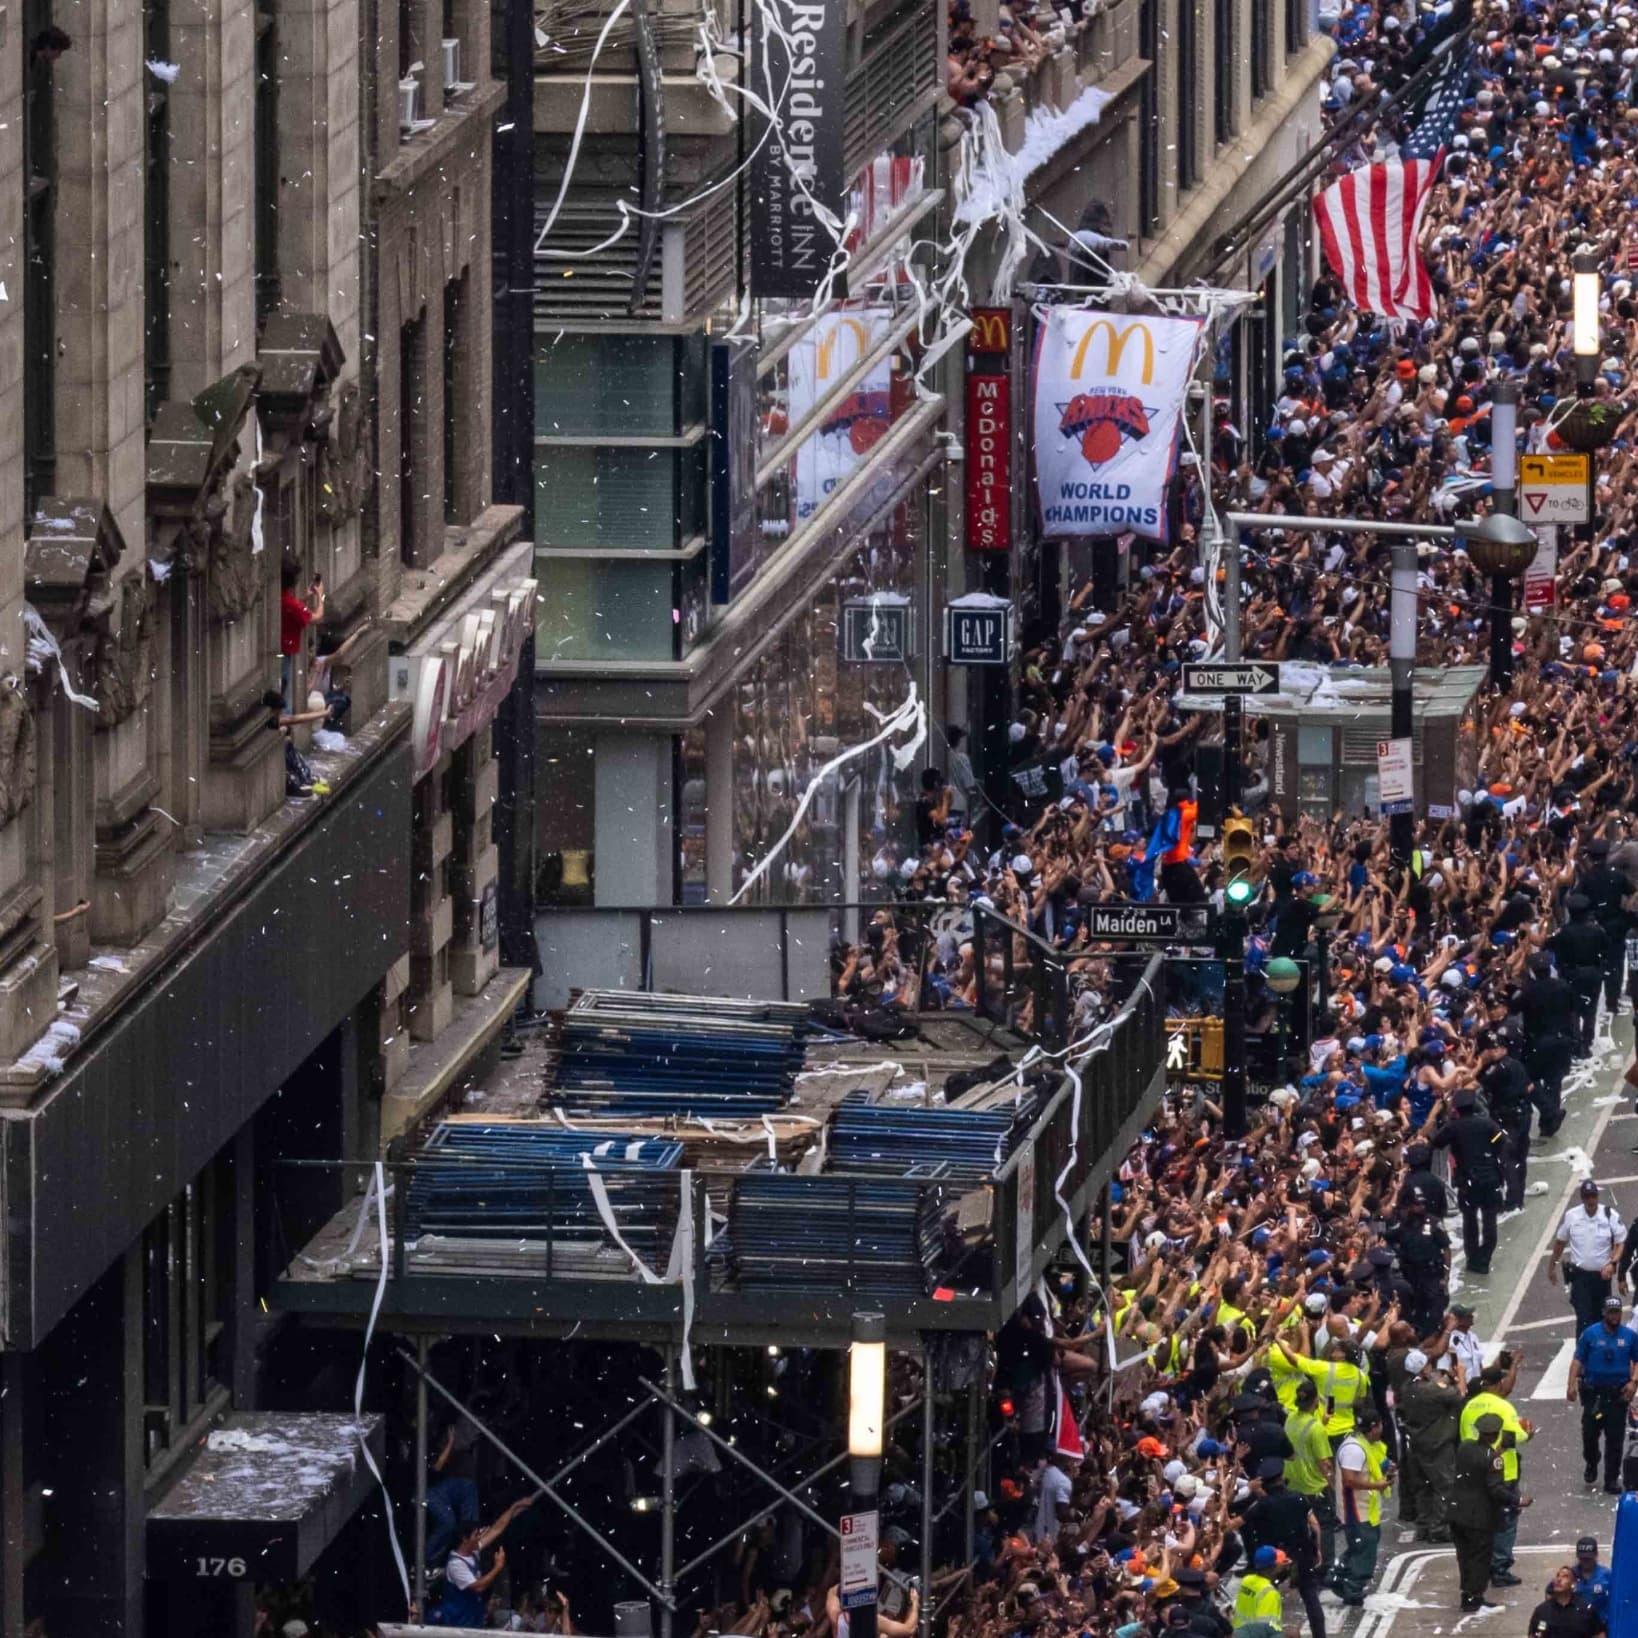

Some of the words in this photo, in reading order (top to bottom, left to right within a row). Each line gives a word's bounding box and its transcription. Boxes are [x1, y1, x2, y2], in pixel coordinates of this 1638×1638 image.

[769, 145, 781, 168] BY
[769, 175, 783, 268] MARRIOTT
[791, 225, 816, 269] INN
[1060, 483, 1132, 500] WORLD
[1548, 499, 1559, 509] TO
[1045, 505, 1158, 525] CHAMPIONS
[961, 618, 994, 646] GAP
[1197, 673, 1225, 686] ONE
[1237, 674, 1266, 687] WAY
[1274, 733, 1286, 796] Newsstand
[1096, 914, 1158, 934] Maiden
[1160, 916, 1172, 926] LA
[843, 1518, 851, 1534] 3
[196, 1557, 246, 1577] 176
